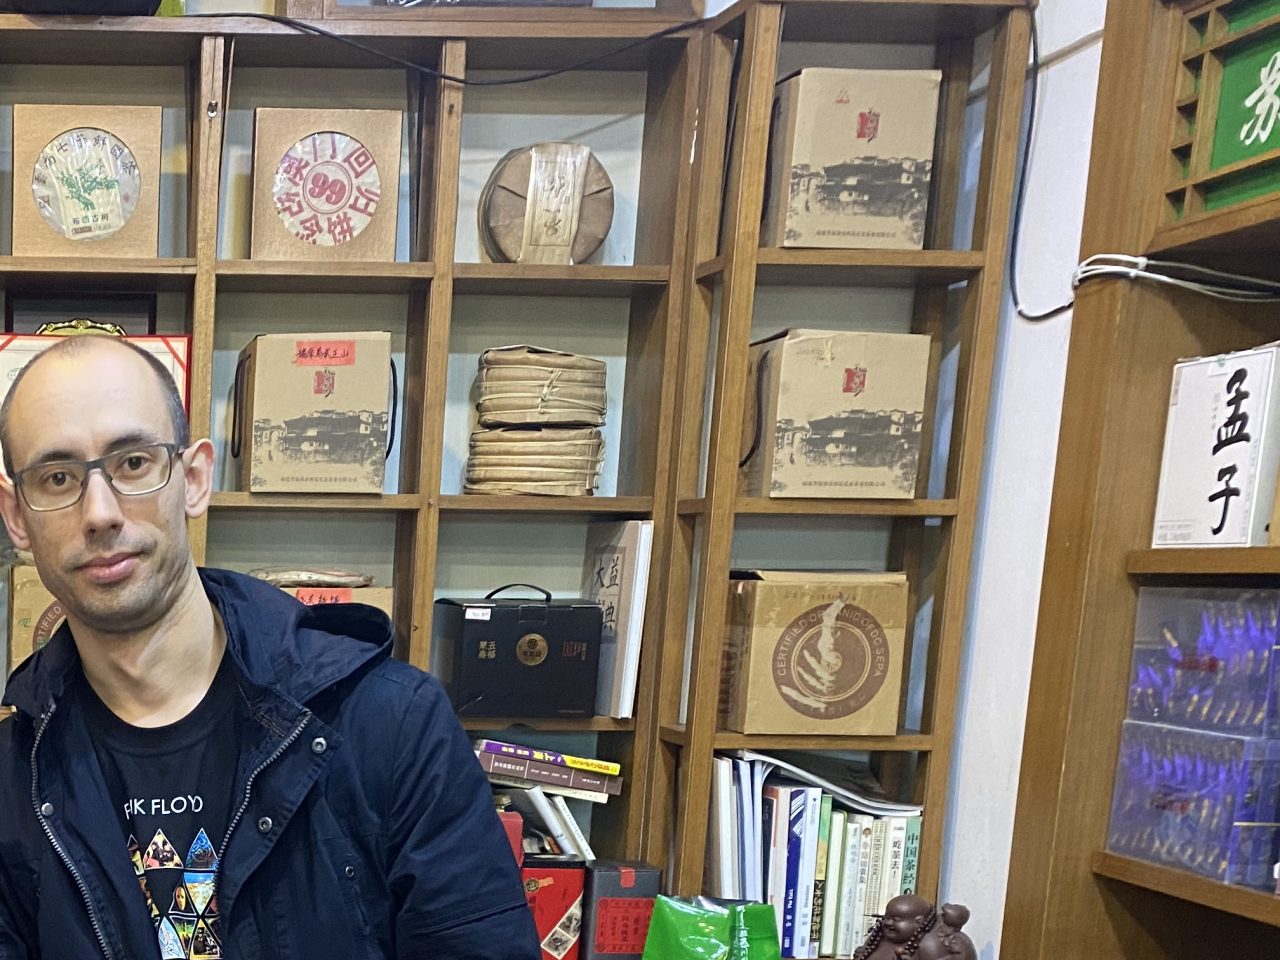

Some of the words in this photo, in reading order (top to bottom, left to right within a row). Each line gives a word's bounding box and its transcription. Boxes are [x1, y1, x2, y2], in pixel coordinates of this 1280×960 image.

[308, 172, 347, 206] 99
[1208, 367, 1252, 536] 孟子
[776, 619, 809, 677] CERTIFIED
[902, 832, 919, 886] 中国茶经
